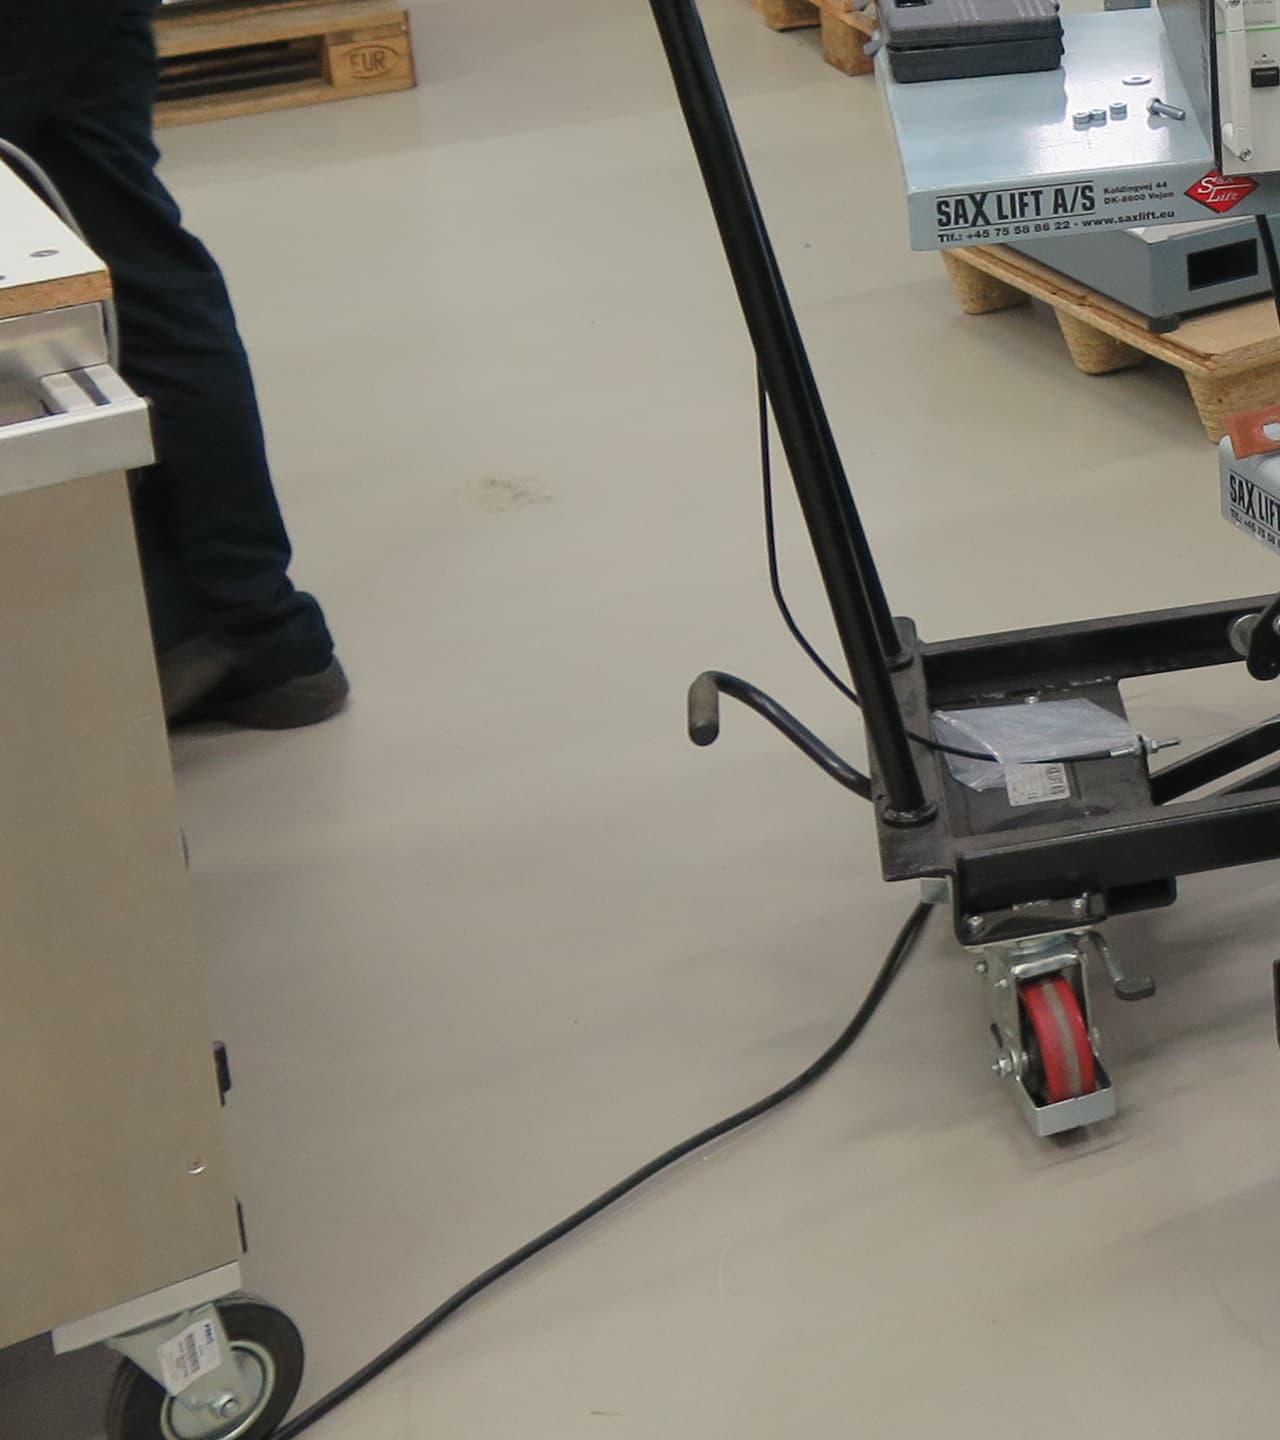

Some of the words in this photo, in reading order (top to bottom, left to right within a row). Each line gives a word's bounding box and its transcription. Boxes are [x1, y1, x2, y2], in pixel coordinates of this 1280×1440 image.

[936, 192, 991, 228] SAX
[997, 191, 1043, 220] LIFT
[1053, 184, 1095, 214] A/S
[1209, 188, 1239, 203] Lift
[966, 229, 990, 240] +45
[995, 228, 1010, 237] 75
[1015, 226, 1030, 235] 58
[1035, 224, 1050, 233] 86
[1054, 221, 1070, 230] 22
[1082, 209, 1175, 228] www.saxlift.eu
[1229, 473, 1256, 519] SAX
